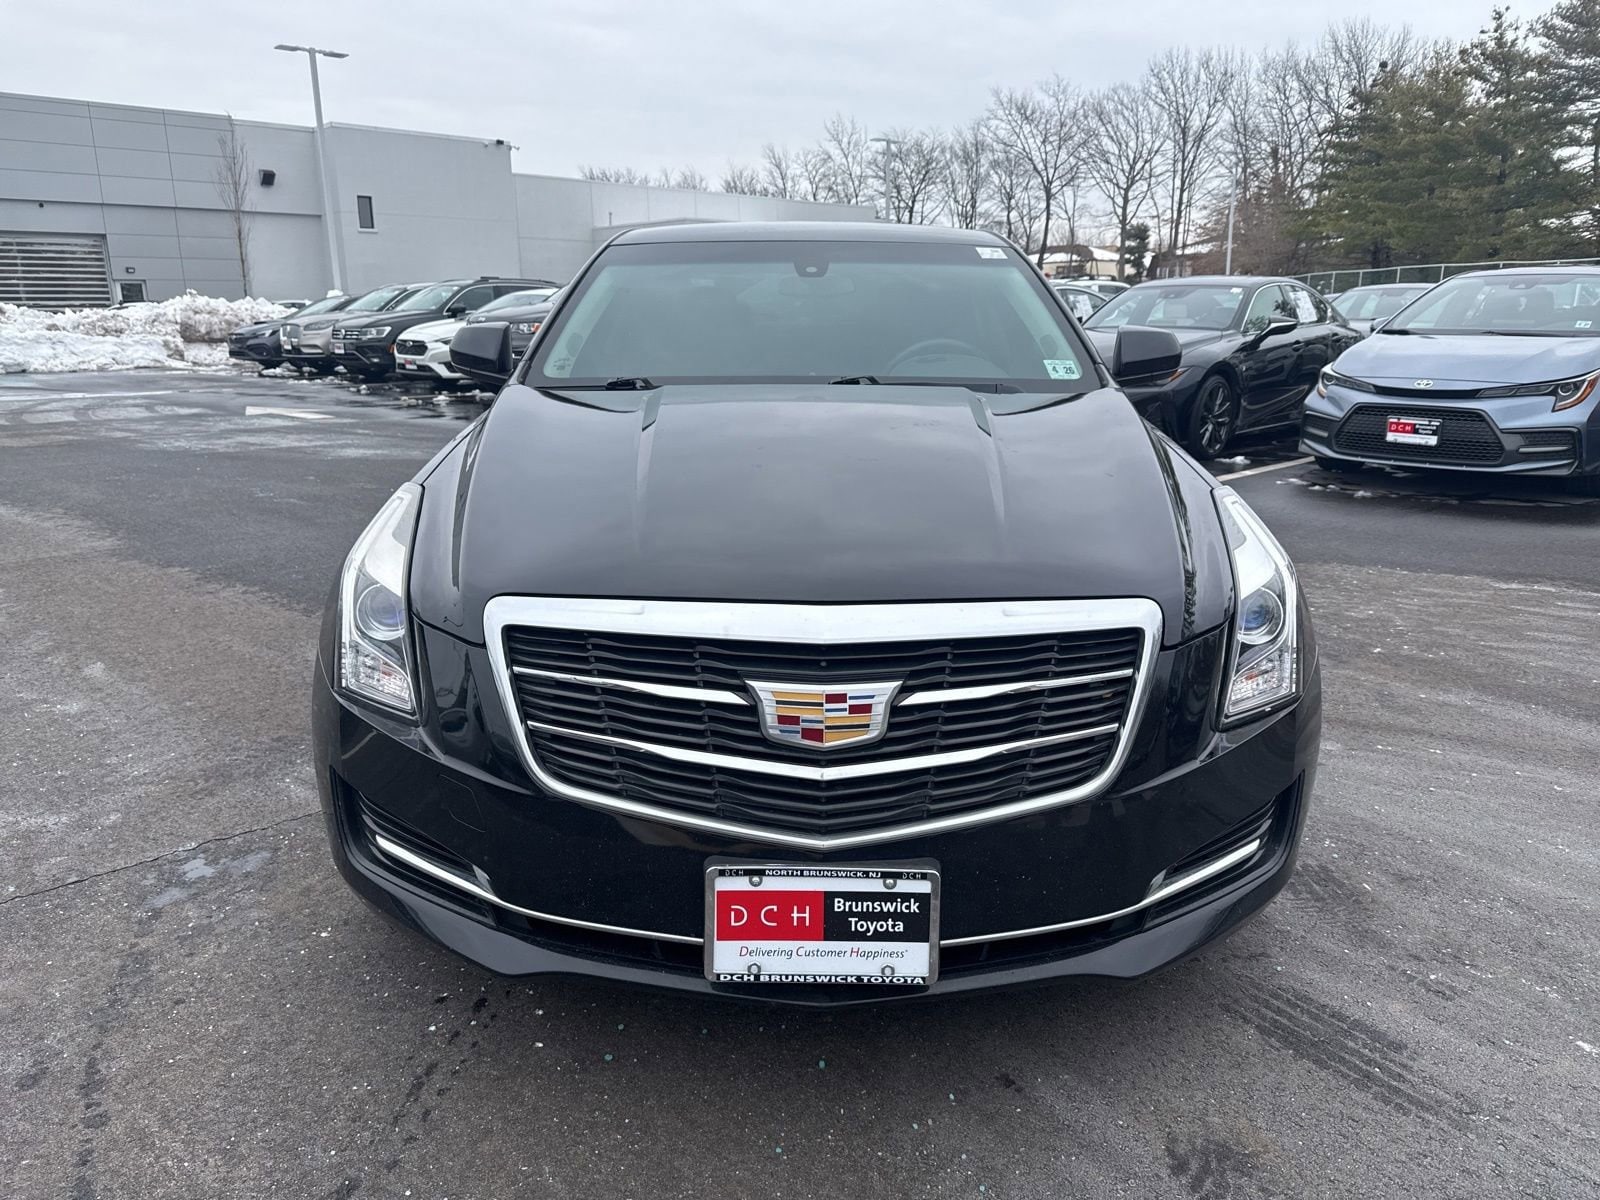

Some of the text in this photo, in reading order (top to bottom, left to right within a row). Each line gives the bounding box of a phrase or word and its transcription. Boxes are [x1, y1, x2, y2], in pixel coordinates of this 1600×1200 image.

[765, 869, 801, 877] NORTH
[834, 898, 920, 913] Brunswick
[730, 905, 810, 927] DCH
[848, 917, 904, 936] Toyota
[739, 946, 793, 960] Delivering
[796, 946, 848, 958] Customer
[719, 974, 924, 984] DCH BRUNSWICK TOYOTA
